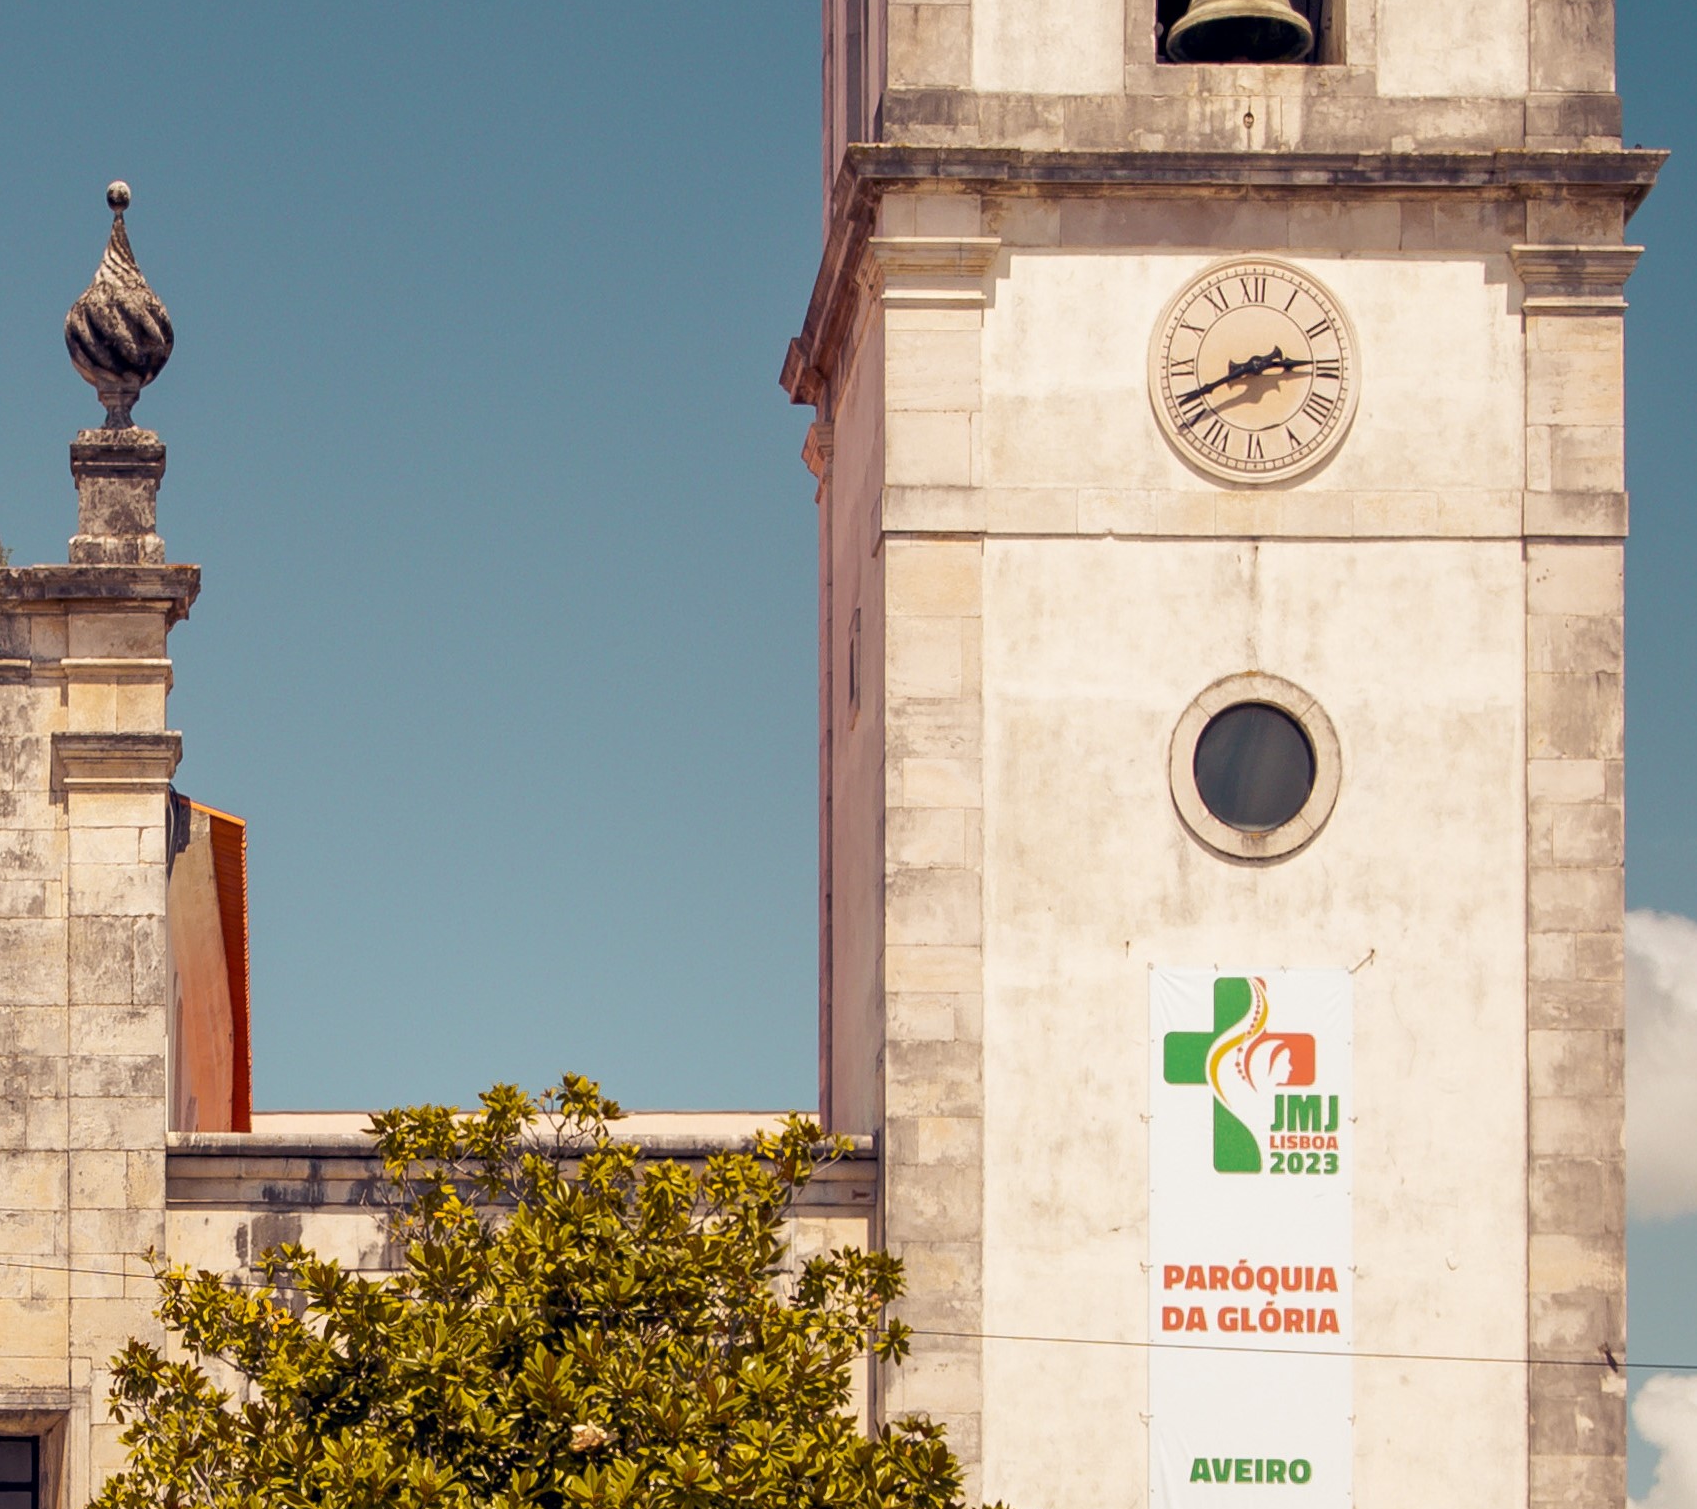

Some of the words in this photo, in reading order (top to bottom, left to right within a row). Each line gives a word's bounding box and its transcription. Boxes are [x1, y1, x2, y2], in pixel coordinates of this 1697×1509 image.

[1204, 286, 1230, 317] XI
[1240, 277, 1267, 304] XII
[1284, 288, 1300, 312] I
[1180, 320, 1205, 339] X
[1305, 318, 1331, 340] II
[1170, 358, 1195, 377] IX
[1316, 358, 1340, 380] III
[1176, 389, 1206, 428] VII
[1303, 391, 1334, 426] IIII
[1203, 419, 1230, 453] VII
[1247, 433, 1264, 459] VI
[1286, 425, 1303, 447] V
[1270, 1094, 1339, 1132] JMJ
[1269, 1135, 1339, 1150] LISBOA
[1270, 1152, 1339, 1174] 2023
[1163, 1259, 1338, 1296] PARÓQUIA
[1162, 1306, 1208, 1332] DA
[1217, 1301, 1340, 1334] GLÓRIA
[1190, 1458, 1312, 1483] AVEIRO
